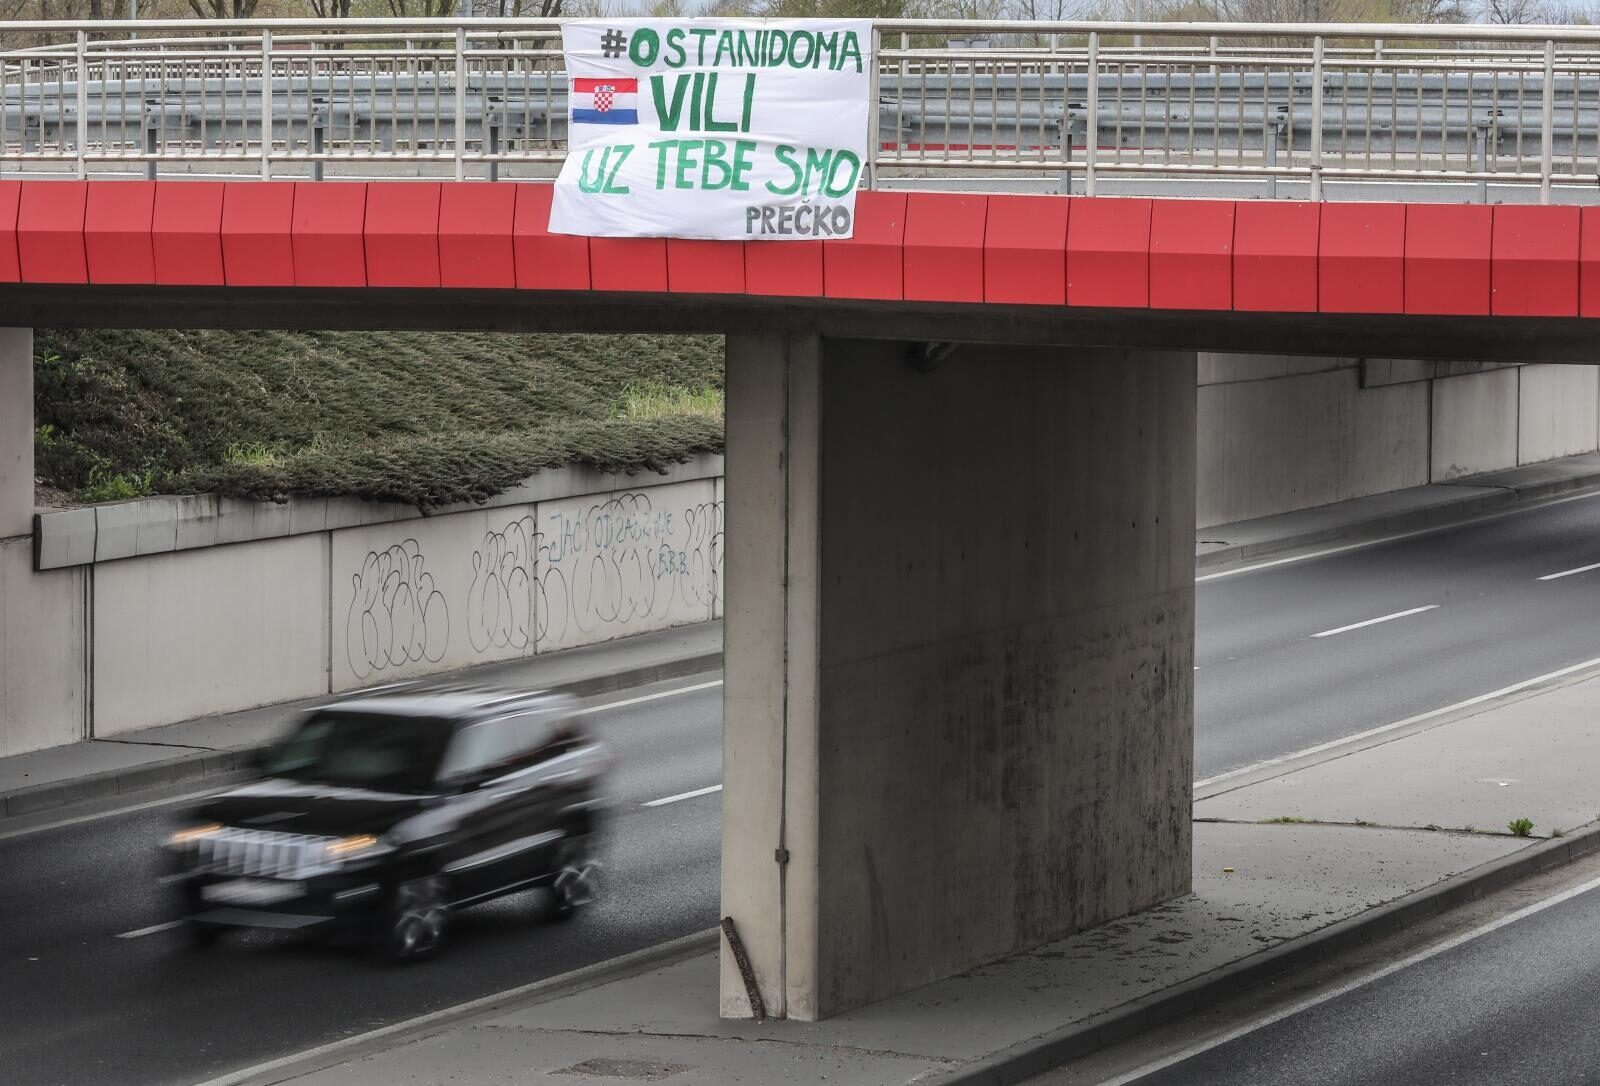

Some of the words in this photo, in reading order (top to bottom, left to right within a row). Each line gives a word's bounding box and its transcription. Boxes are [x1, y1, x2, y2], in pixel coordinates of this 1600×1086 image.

[600, 27, 863, 74] #OSTANIDOMA
[650, 72, 757, 132] VILI
[578, 144, 635, 194] UZ
[648, 139, 758, 191] TEBE
[765, 144, 861, 199] SMO
[745, 200, 851, 236] PREČKO
